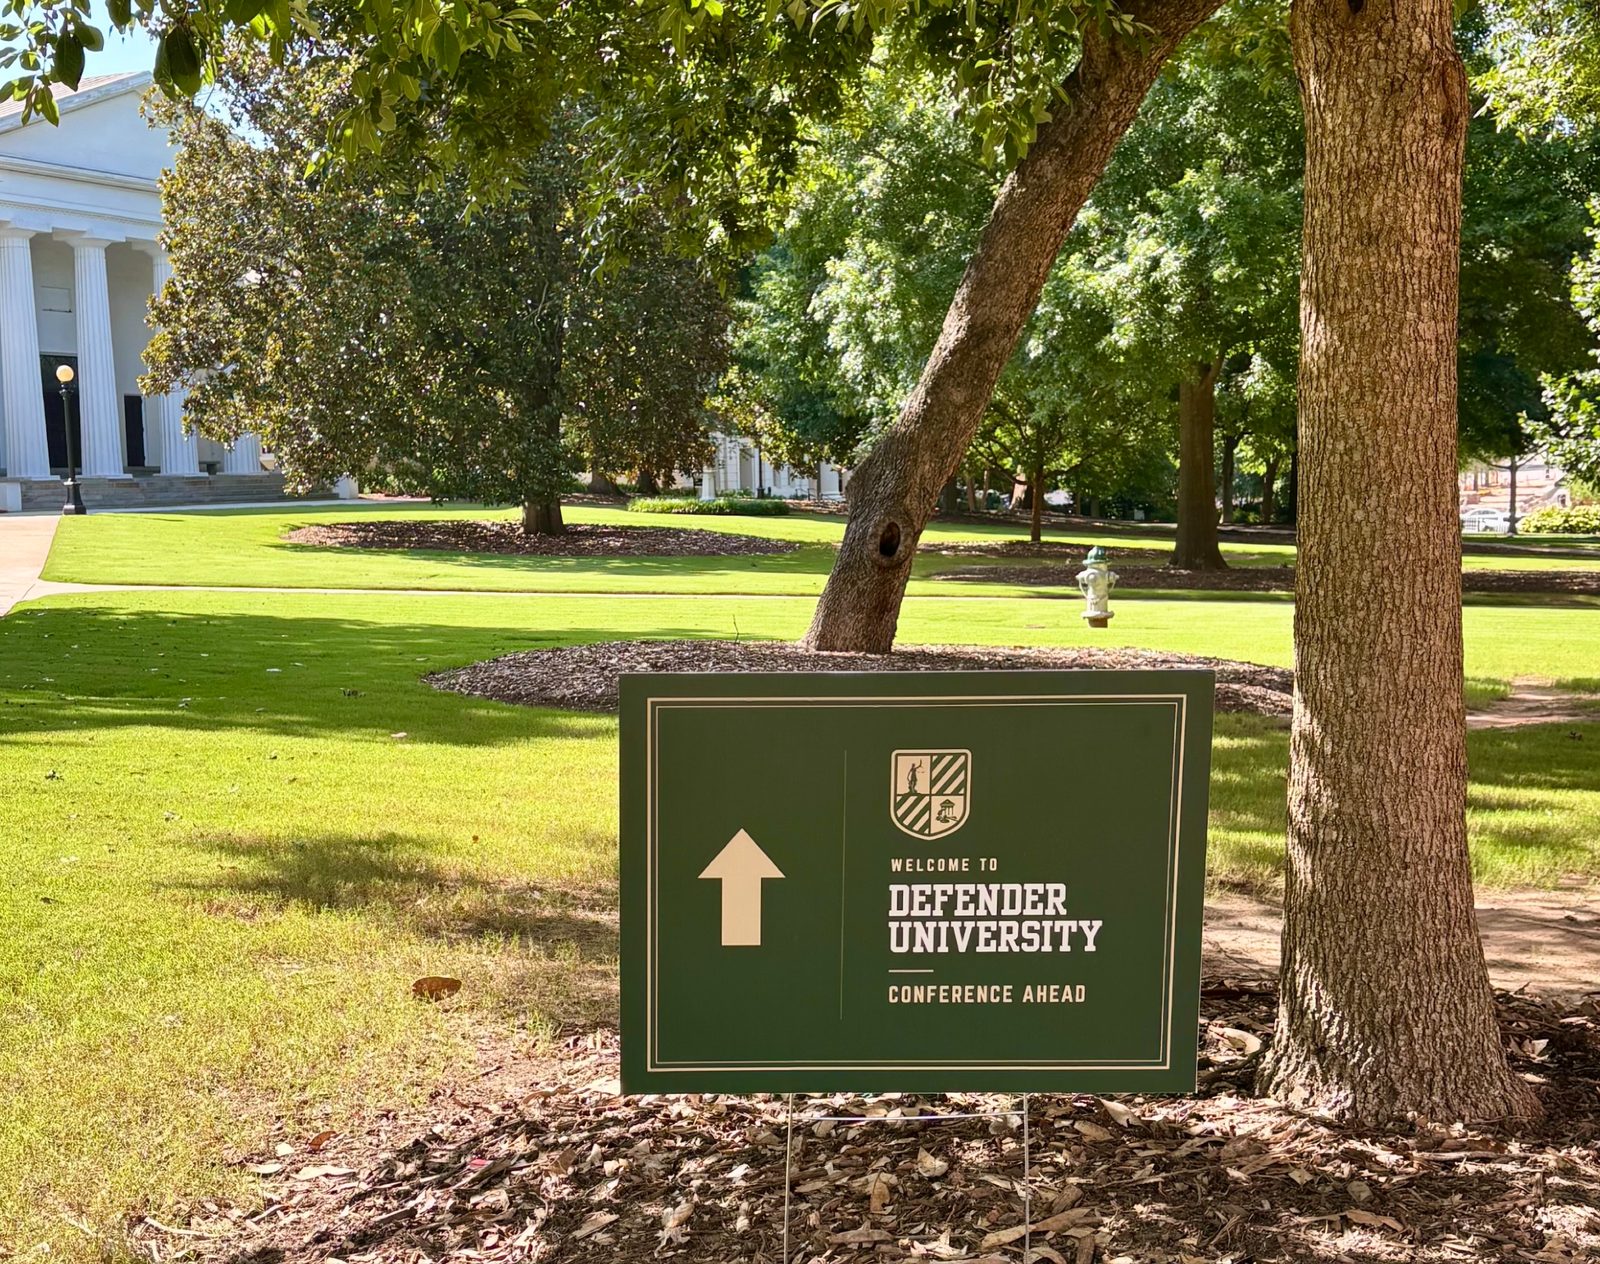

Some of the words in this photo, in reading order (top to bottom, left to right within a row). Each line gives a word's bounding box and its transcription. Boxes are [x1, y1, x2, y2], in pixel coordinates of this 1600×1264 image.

[890, 858, 970, 872] WELCOME
[979, 857, 998, 871] TO
[888, 883, 1068, 917] DEFENDER
[888, 920, 1103, 953] UNIVERSITY
[888, 985, 1013, 1004] CONFERENCE
[1022, 984, 1086, 1003] AHEAD
